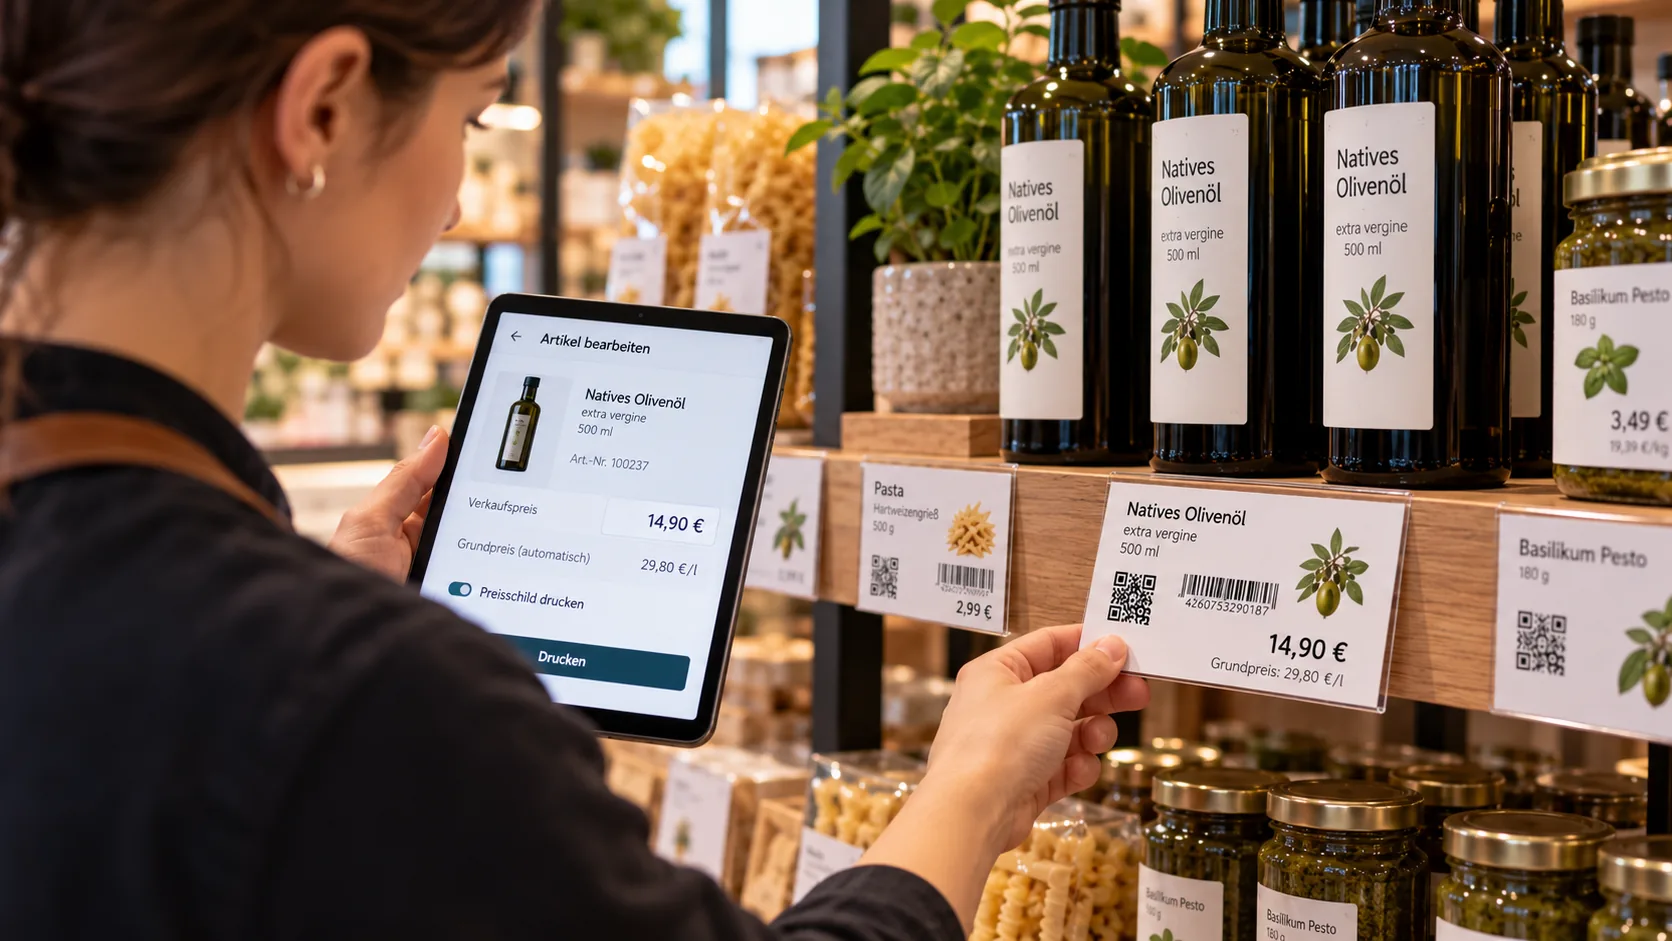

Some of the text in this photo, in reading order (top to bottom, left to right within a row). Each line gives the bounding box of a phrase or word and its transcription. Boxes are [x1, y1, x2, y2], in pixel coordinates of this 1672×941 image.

[1337, 147, 1398, 170] Natives
[1162, 158, 1215, 179] Natives
[1008, 180, 1053, 199] Natives
[1336, 173, 1406, 198] Olivenöl
[1161, 183, 1221, 207] Olivenöl
[1008, 202, 1059, 223] Olivenöl
[1161, 227, 1224, 244] extra vergine
[1336, 220, 1408, 238] extra vergine
[1027, 242, 1061, 257] vergine
[1167, 248, 1200, 261] 500 ml
[1344, 242, 1381, 256] 500 ml
[1012, 260, 1039, 274] 500 ml
[1571, 287, 1670, 305] Basilikum Pesto
[1571, 314, 1596, 329] 180 g
[540, 333, 650, 355] Artikel bearbeiten
[586, 388, 686, 410] Natives Olivenöl
[582, 408, 647, 424] extra vergine
[1611, 410, 1668, 433] 3,49 €
[578, 424, 613, 437] 500 ml
[570, 454, 649, 472] Art.-Nr. 100237
[874, 481, 904, 498] Pasta
[468, 498, 538, 516] Verkaufspreis
[874, 504, 938, 521] Hartweizengrieß
[1127, 502, 1246, 526] Natives Olivenöl
[648, 514, 704, 534] 14,90 €
[873, 521, 894, 535] 500 g
[1123, 525, 1197, 542] extra vergine
[458, 538, 590, 565] Grundpreis (automatisch)
[1120, 542, 1159, 557] 500 ml
[1519, 538, 1647, 568] Basilikum Pesto
[641, 559, 698, 576] 29,80 €/l
[1519, 566, 1549, 584] 180 g
[480, 588, 584, 610] Preisschild drucken
[1186, 598, 1269, 616] 4260753290187
[956, 600, 992, 620] 2,99 €
[1269, 634, 1348, 662] 14,90 €
[538, 651, 586, 668] Drucken
[1211, 657, 1344, 688] Grundpreis: 29,80 €/l
[1180, 898, 1205, 911] Pesto
[1267, 909, 1336, 934] Basilikum Pesto
